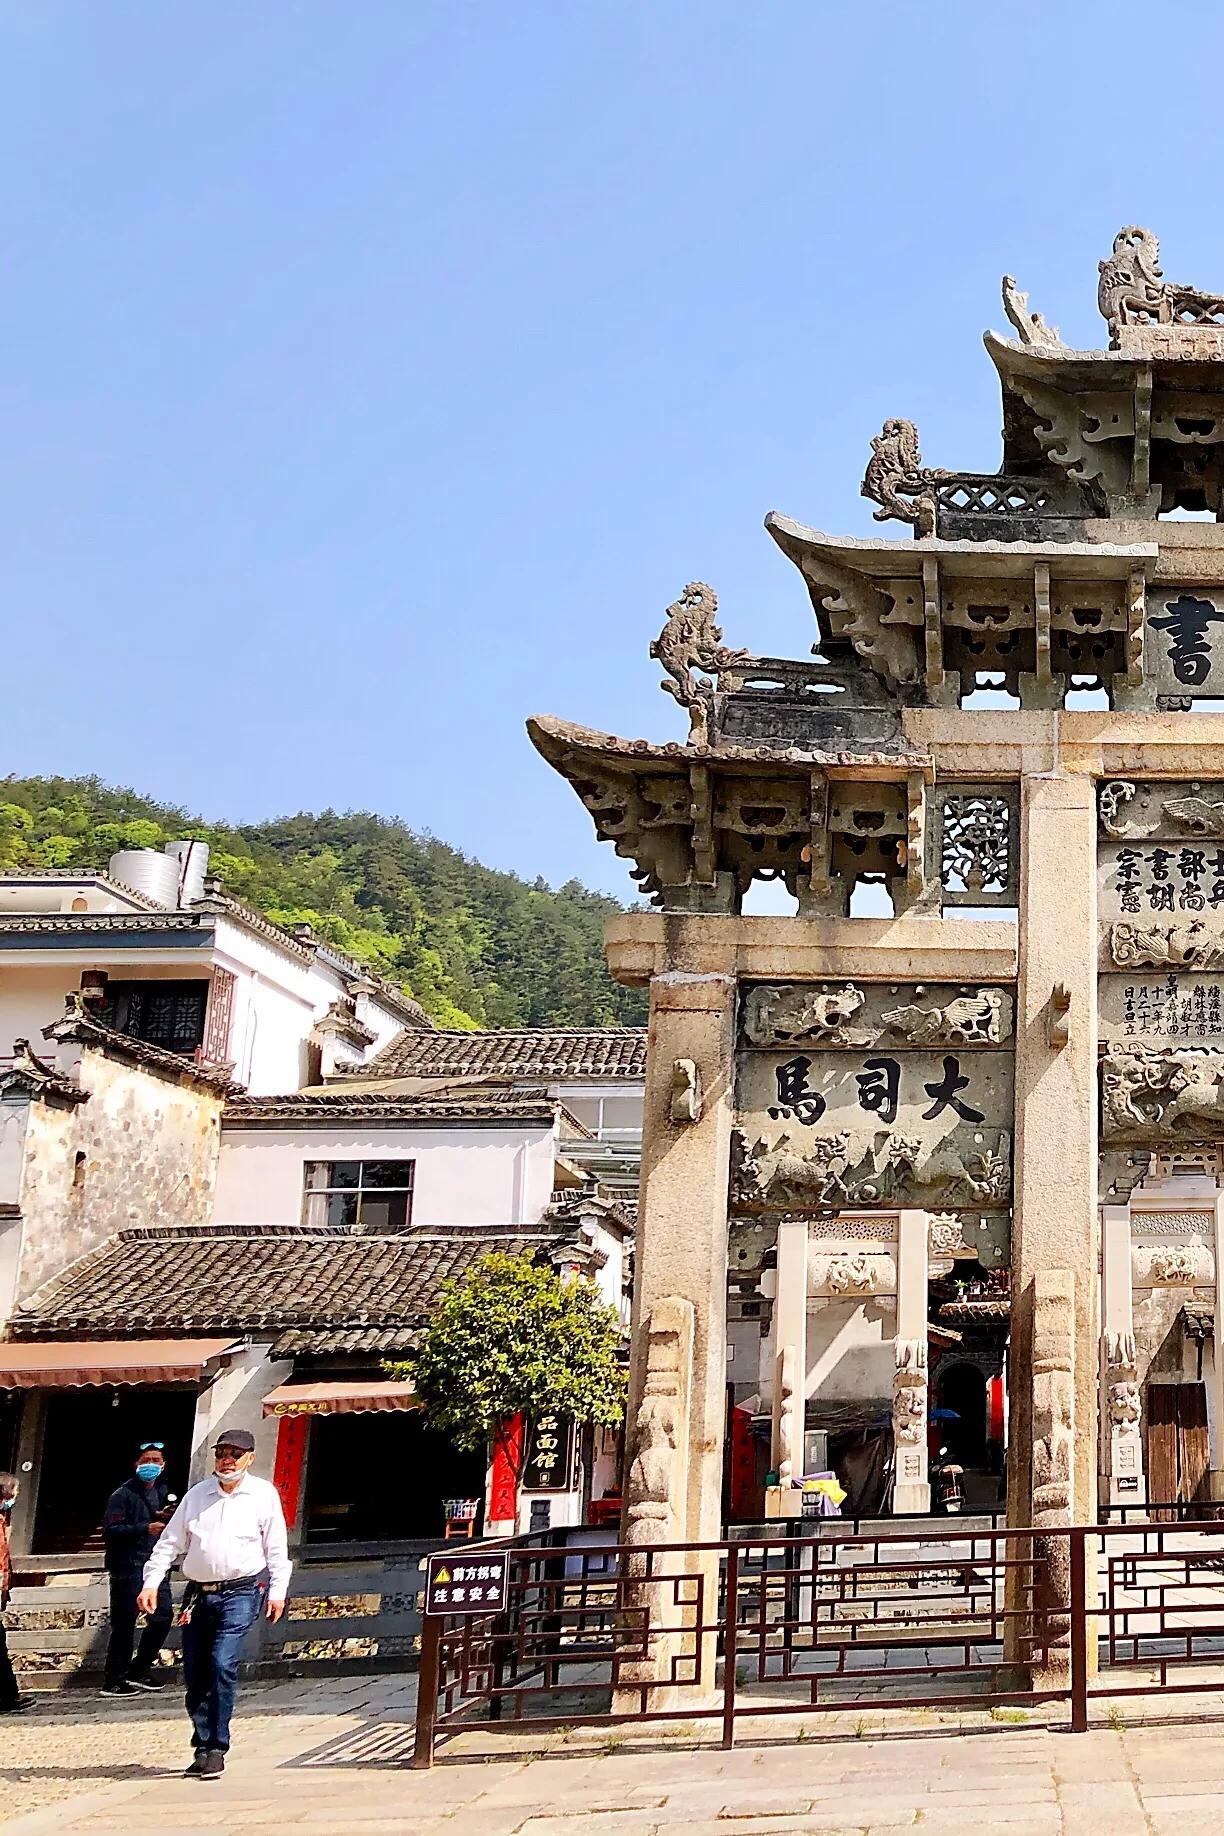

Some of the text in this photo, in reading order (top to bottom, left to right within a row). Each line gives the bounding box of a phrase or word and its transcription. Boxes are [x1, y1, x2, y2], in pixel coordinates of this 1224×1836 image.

[767, 1055, 985, 1126] 大司馬
[531, 1415, 559, 1468] 品面馆
[453, 1565, 502, 1582] 前方拐弯
[434, 1586, 500, 1603] 注意安全
